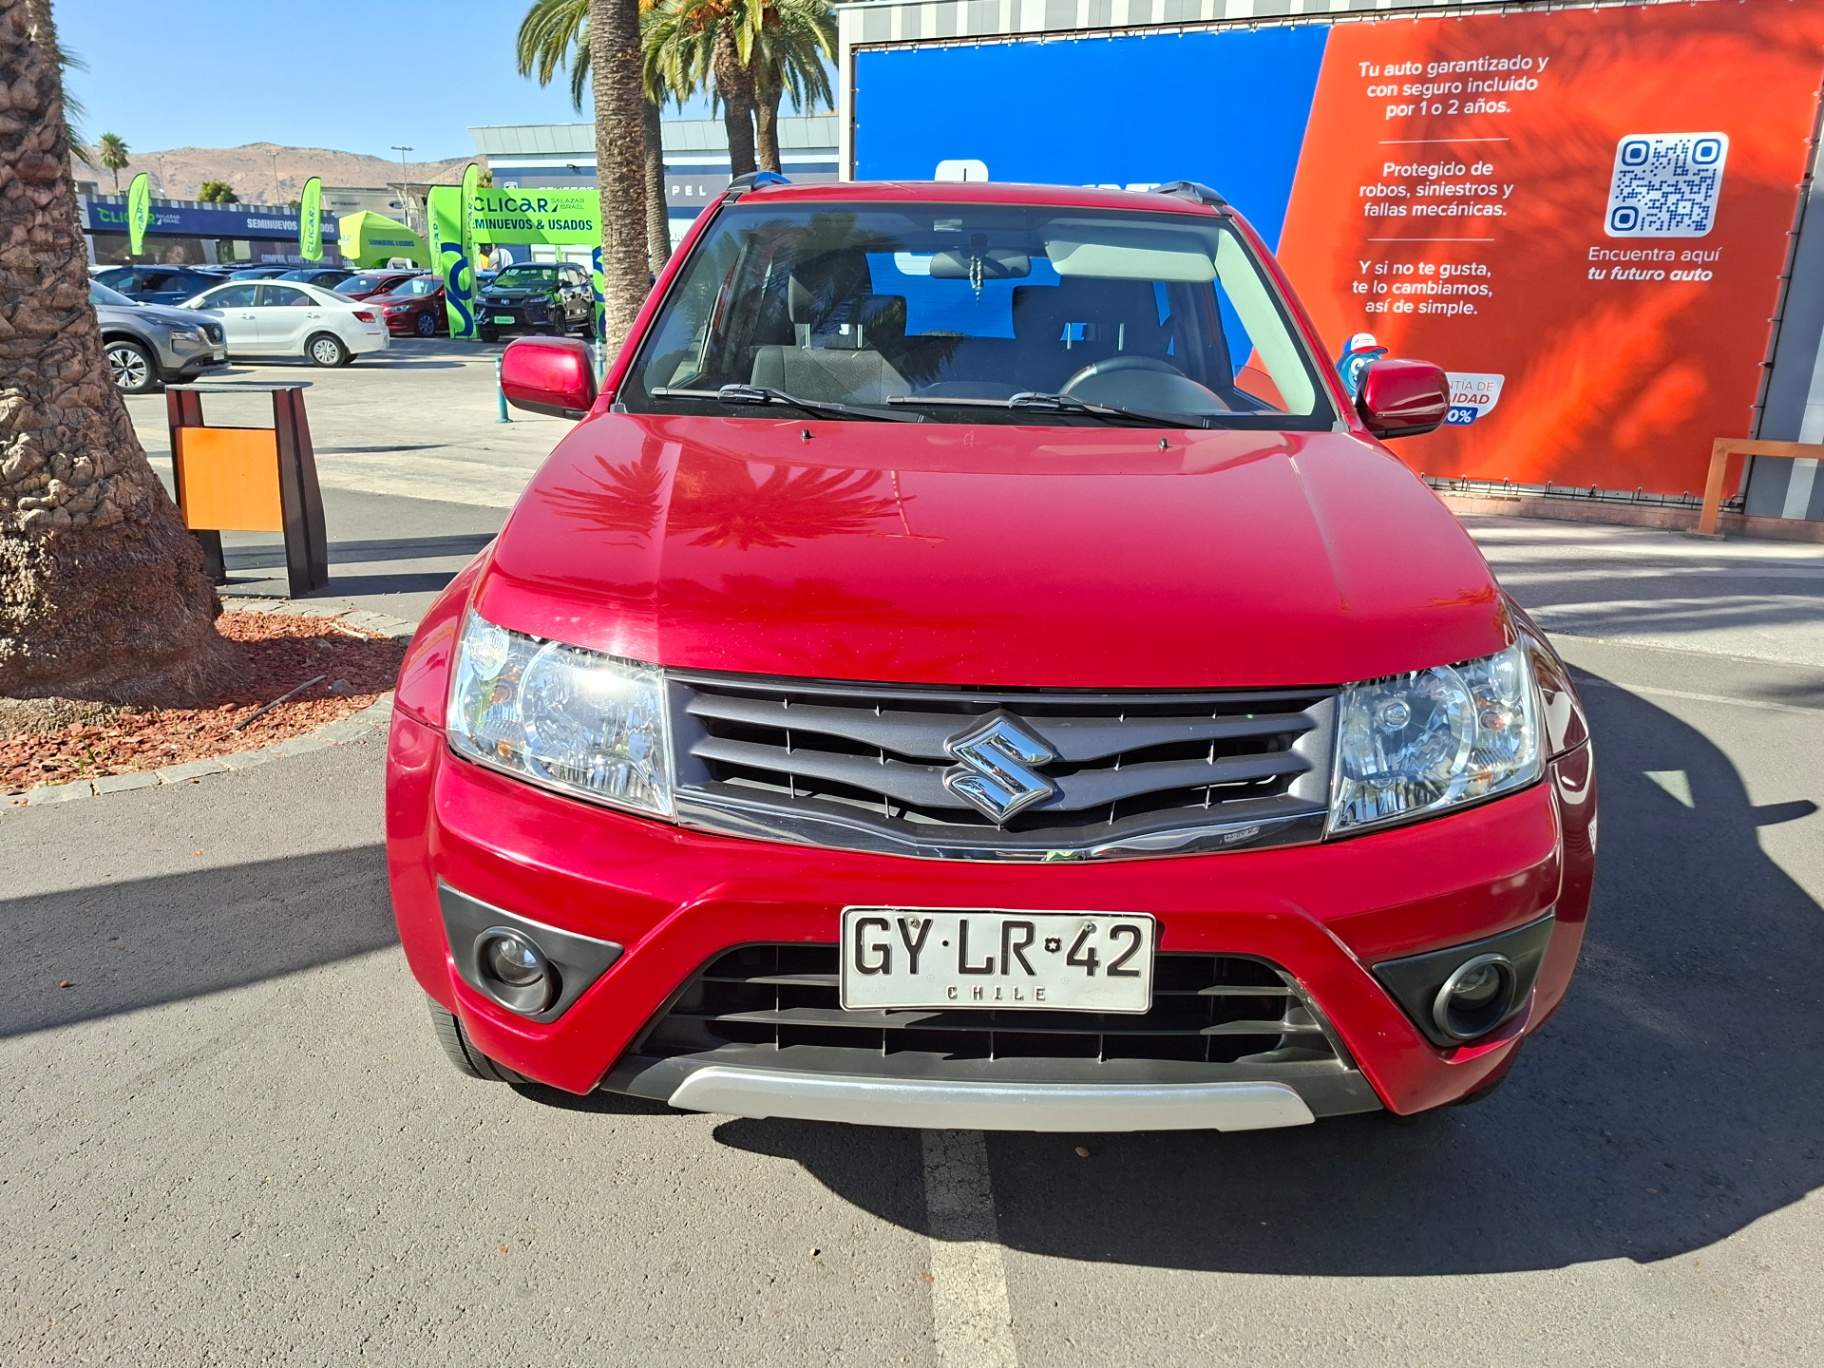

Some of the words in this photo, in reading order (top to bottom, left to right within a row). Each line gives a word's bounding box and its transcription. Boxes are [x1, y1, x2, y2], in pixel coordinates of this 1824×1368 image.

[1359, 61, 1379, 77] Tu
[1384, 61, 1422, 77] auto
[1427, 55, 1532, 78] garantizado
[1537, 56, 1549, 72] y
[1367, 84, 1398, 97] con
[1402, 82, 1462, 98] seguro
[1467, 76, 1538, 93] incluido
[1385, 103, 1415, 120] por
[1419, 101, 1426, 115] 1
[1431, 104, 1442, 115] o
[1447, 100, 1458, 115] 2
[1464, 98, 1511, 114] años.
[1382, 161, 1466, 180] Protegido
[1471, 160, 1494, 176] de
[664, 185, 707, 196] PEL
[1359, 182, 1411, 198] robos,
[1416, 181, 1498, 197] siniestros
[1502, 184, 1514, 199] y
[1364, 202, 1407, 217] fallas
[1412, 201, 1507, 217] mecánicas.
[473, 218, 532, 230] MINUEVOS
[536, 219, 545, 230] &
[548, 219, 592, 230] USADOS
[1588, 246, 1676, 261] Encuentra
[1680, 246, 1723, 264] aquí
[1359, 260, 1372, 274] Y
[1374, 260, 1388, 274] si
[1393, 263, 1414, 275] no
[1418, 261, 1435, 275] te
[1439, 262, 1491, 279] gusta,
[1587, 266, 1606, 280] tu
[1610, 266, 1665, 281] futuro
[1669, 267, 1713, 281] auto
[1352, 280, 1368, 294] te
[1372, 280, 1388, 294] lo
[1391, 280, 1493, 298] cambiamos,
[1365, 298, 1391, 313] así
[1392, 299, 1414, 313] de
[1418, 299, 1478, 317] simple.
[1477, 381, 1496, 391] DE
[1453, 392, 1490, 405] IDAD
[1447, 408, 1472, 423] 0%
[946, 985, 1046, 1001] CHILE
